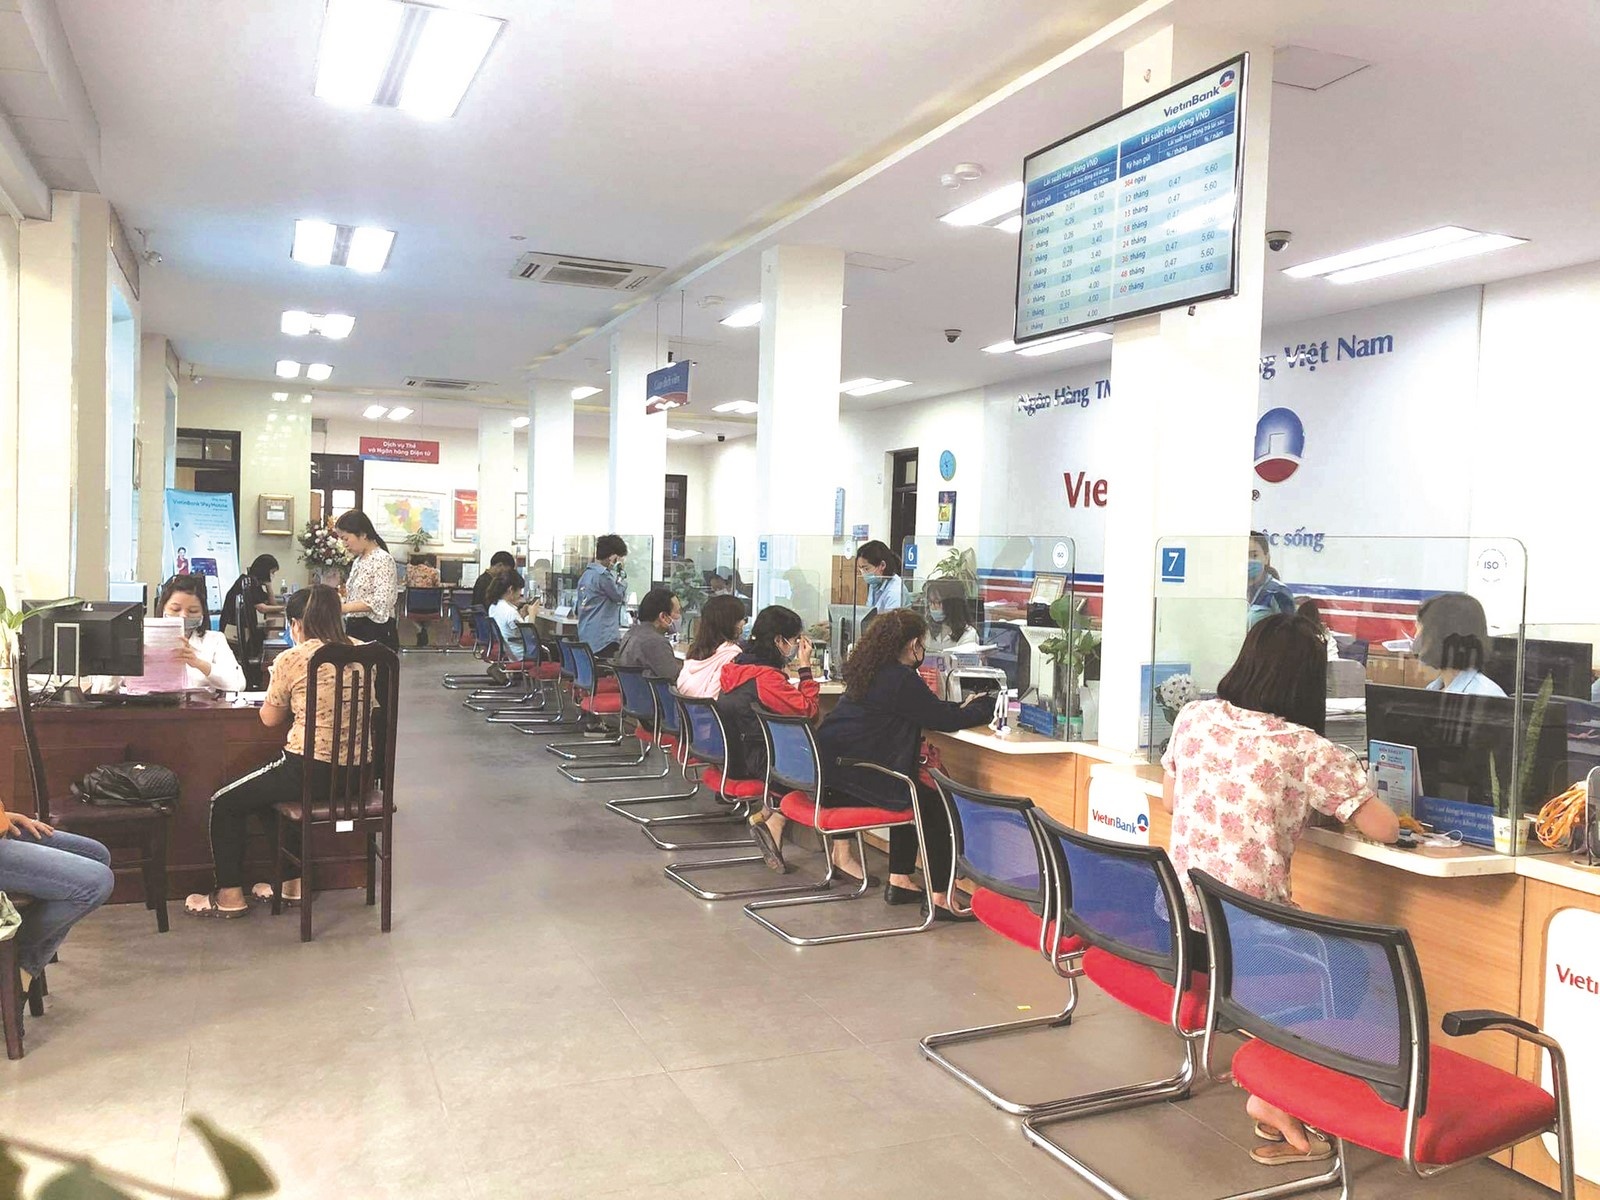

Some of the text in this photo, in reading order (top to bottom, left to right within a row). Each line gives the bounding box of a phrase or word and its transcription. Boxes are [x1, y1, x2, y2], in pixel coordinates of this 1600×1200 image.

[1163, 86, 1220, 117] VietinBank
[1141, 108, 1211, 145] Lãi suất Huy động VNĐ
[1133, 189, 1149, 200] tháng
[1132, 205, 1149, 215] tháng
[1131, 219, 1148, 230] tháng
[1130, 235, 1147, 245] tháng
[1130, 250, 1146, 261] tháng
[1129, 265, 1145, 276] tháng
[1128, 281, 1145, 291] tháng
[1284, 341, 1329, 372] Việt
[1337, 334, 1393, 361] Nam
[1054, 386, 1090, 408] Hàng
[394, 448, 409, 456] hàng
[1284, 526, 1326, 552] sống
[908, 546, 914, 562] 6
[1168, 552, 1180, 571] 7
[1484, 561, 1499, 570] ISO
[1092, 809, 1137, 835] VietinBank
